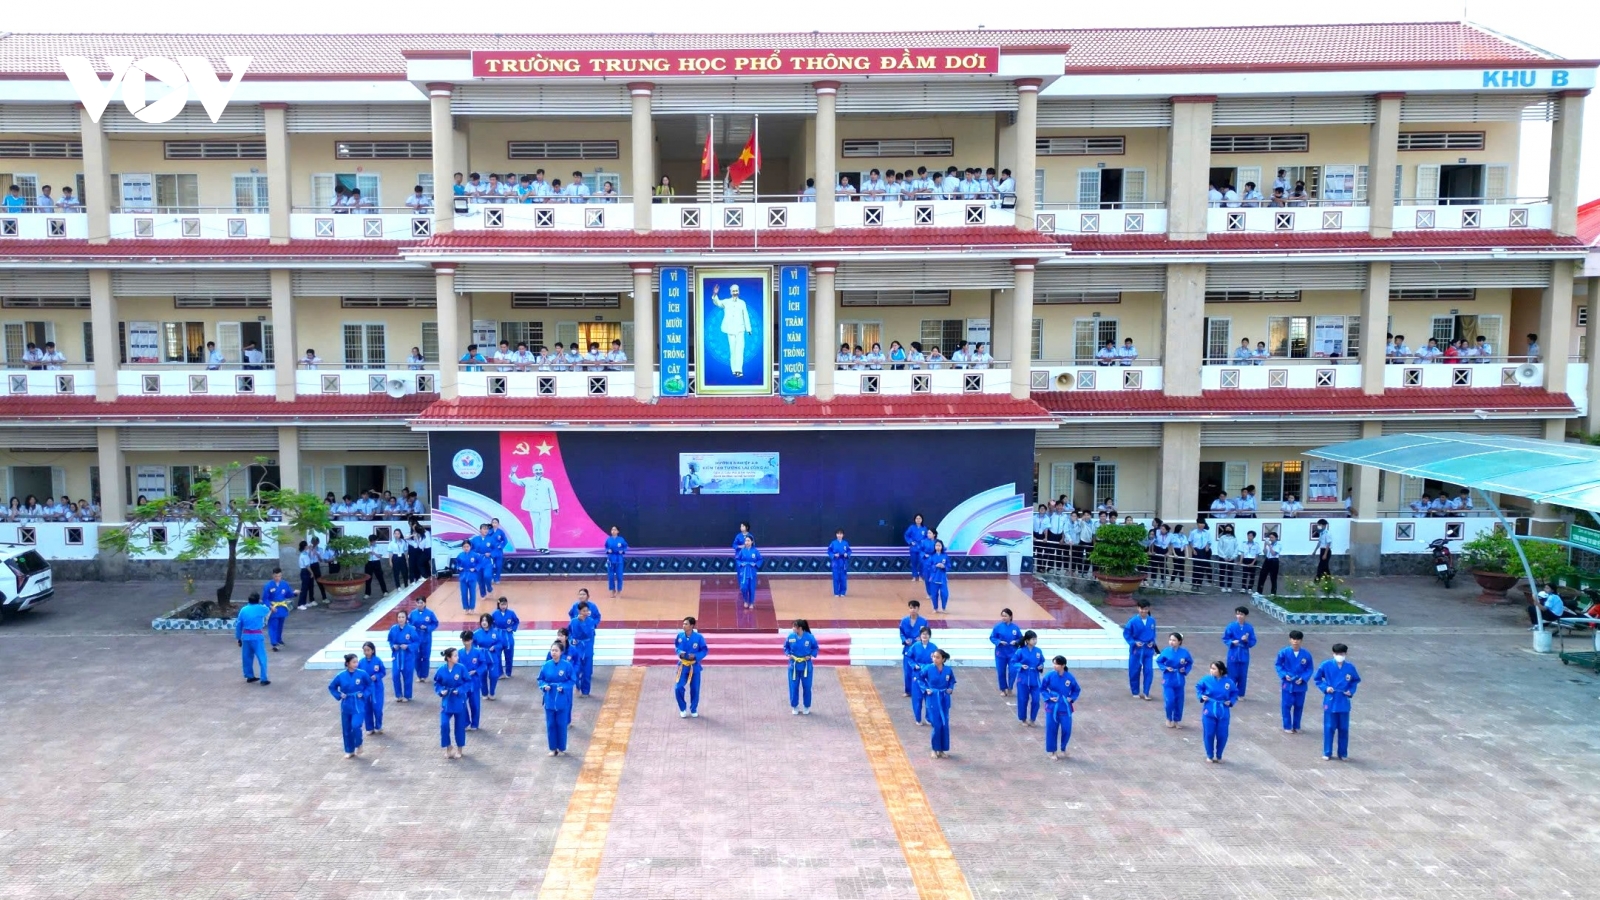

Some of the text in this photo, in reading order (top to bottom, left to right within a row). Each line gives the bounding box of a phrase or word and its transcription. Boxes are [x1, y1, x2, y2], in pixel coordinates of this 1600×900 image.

[485, 48, 986, 74] TRƯỜNG TRUNG HỌC PHỔ THÔNG ĐẦM DƠI
[1482, 70, 1569, 87] KHU B
[663, 270, 685, 374] VÌ LỢI ÍCH MƯỜI NĂM TRỒNG CÂY
[783, 268, 805, 373] VÌ LỢI ÍCH TRĂM NĂM TRỒNG NGƯỜI
